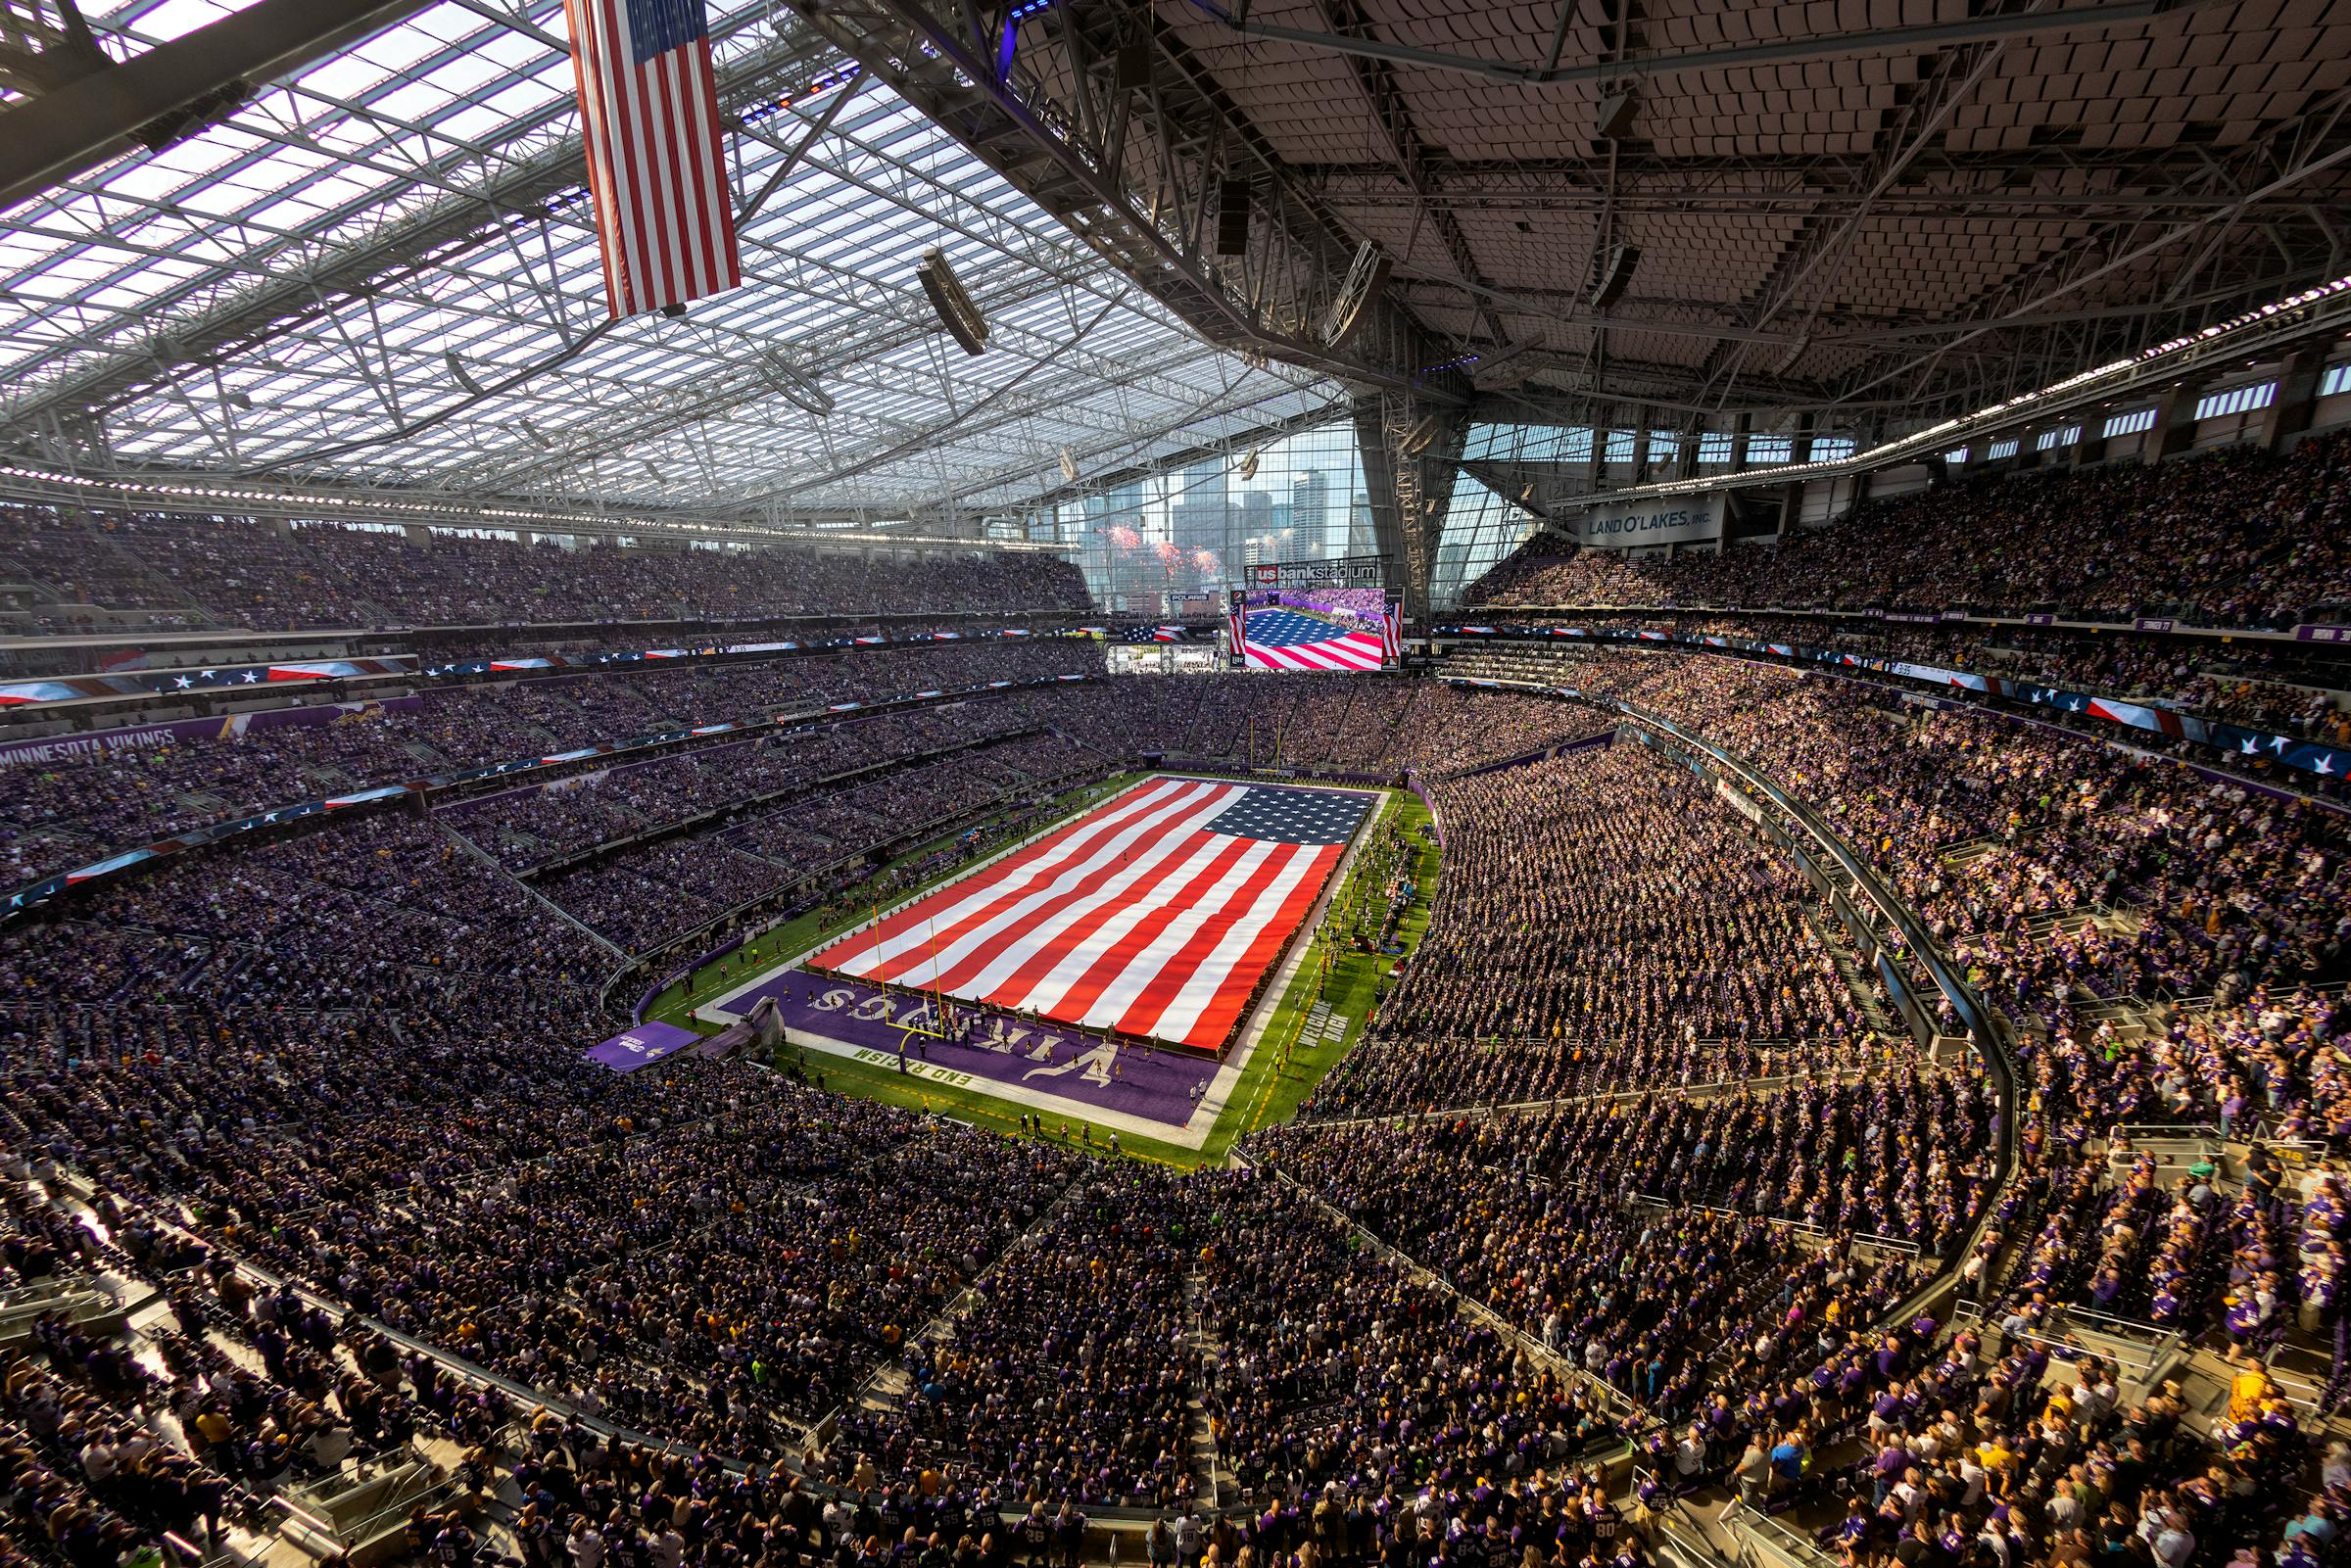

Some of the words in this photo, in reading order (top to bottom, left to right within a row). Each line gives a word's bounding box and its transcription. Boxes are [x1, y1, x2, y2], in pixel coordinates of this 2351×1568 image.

[1589, 519, 1622, 535] LAND
[1624, 510, 1690, 533] O'LAKES,
[1693, 512, 1711, 525] INC.
[0, 739, 102, 769] MINNESOTA
[105, 728, 176, 753] VIKINGS
[1571, 741, 1607, 756] PENTAIR
[1298, 999, 1333, 1048] WELCOME
[1322, 1013, 1349, 1043] BACK
[931, 1068, 974, 1087] END
[1595, 1522, 1615, 1539] 80
[439, 1547, 457, 1562] 18
